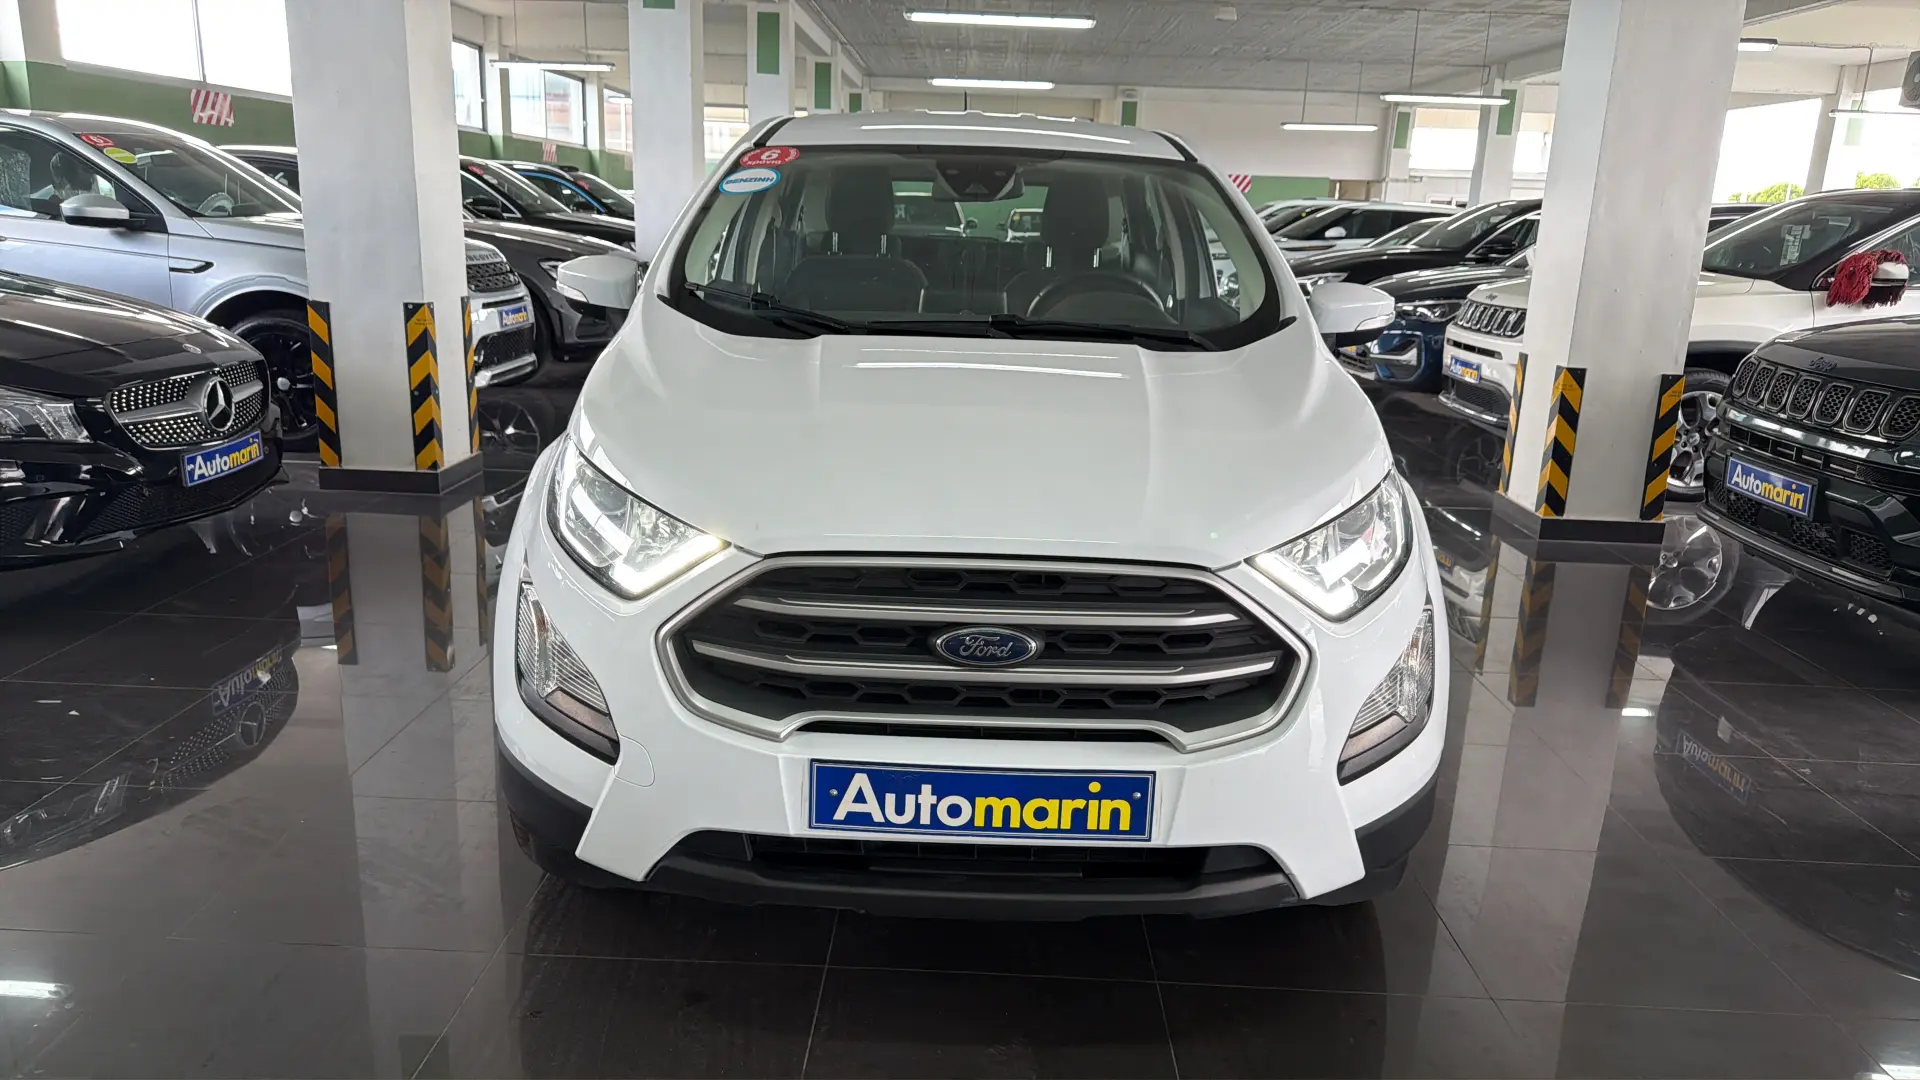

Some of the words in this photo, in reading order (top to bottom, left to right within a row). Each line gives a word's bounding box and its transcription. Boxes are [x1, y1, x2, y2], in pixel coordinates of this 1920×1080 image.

[760, 148, 781, 160] 6
[193, 437, 261, 481] Automarin
[1730, 463, 1805, 510] Automarin
[958, 634, 1014, 657] Ford
[832, 772, 1132, 831] Automarin
